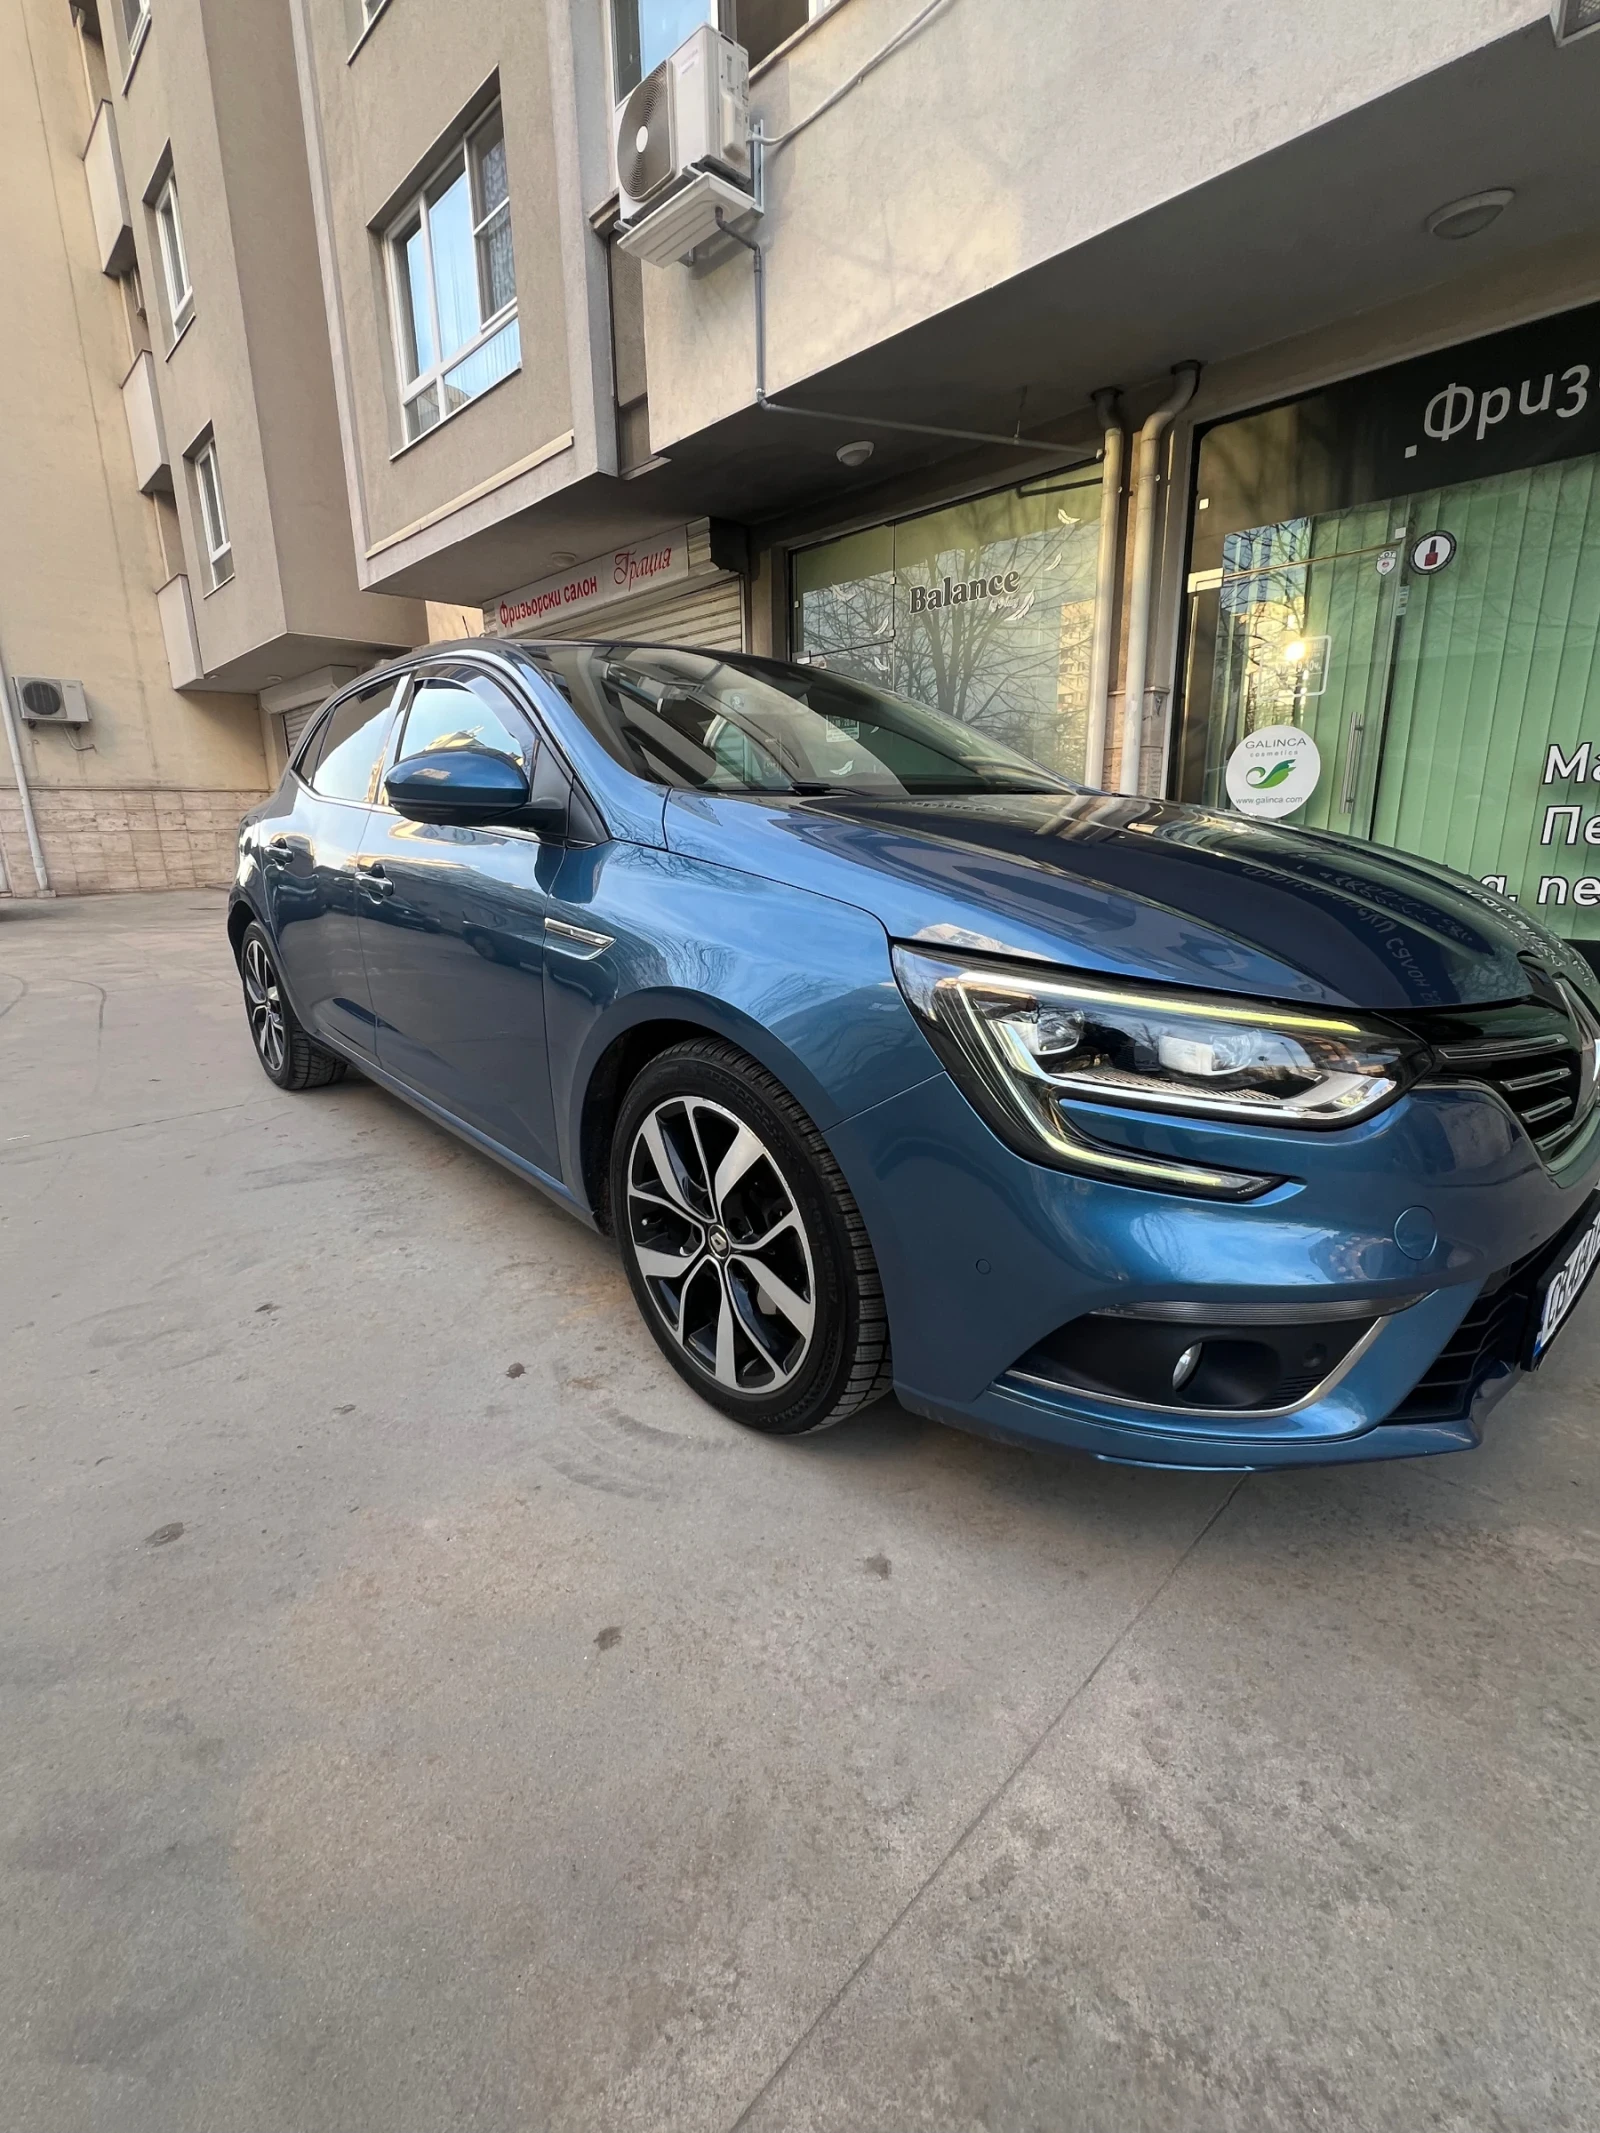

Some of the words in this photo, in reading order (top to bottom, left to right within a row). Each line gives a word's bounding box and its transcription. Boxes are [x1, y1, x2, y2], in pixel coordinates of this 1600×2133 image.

[1424, 364, 1600, 441] Фриз
[500, 592, 562, 628] Фризьорски
[563, 575, 598, 603] салон
[613, 547, 673, 592] Грация
[909, 570, 1020, 614] Balance
[1245, 738, 1307, 750] GALINCA
[1250, 750, 1298, 758] cosmetics
